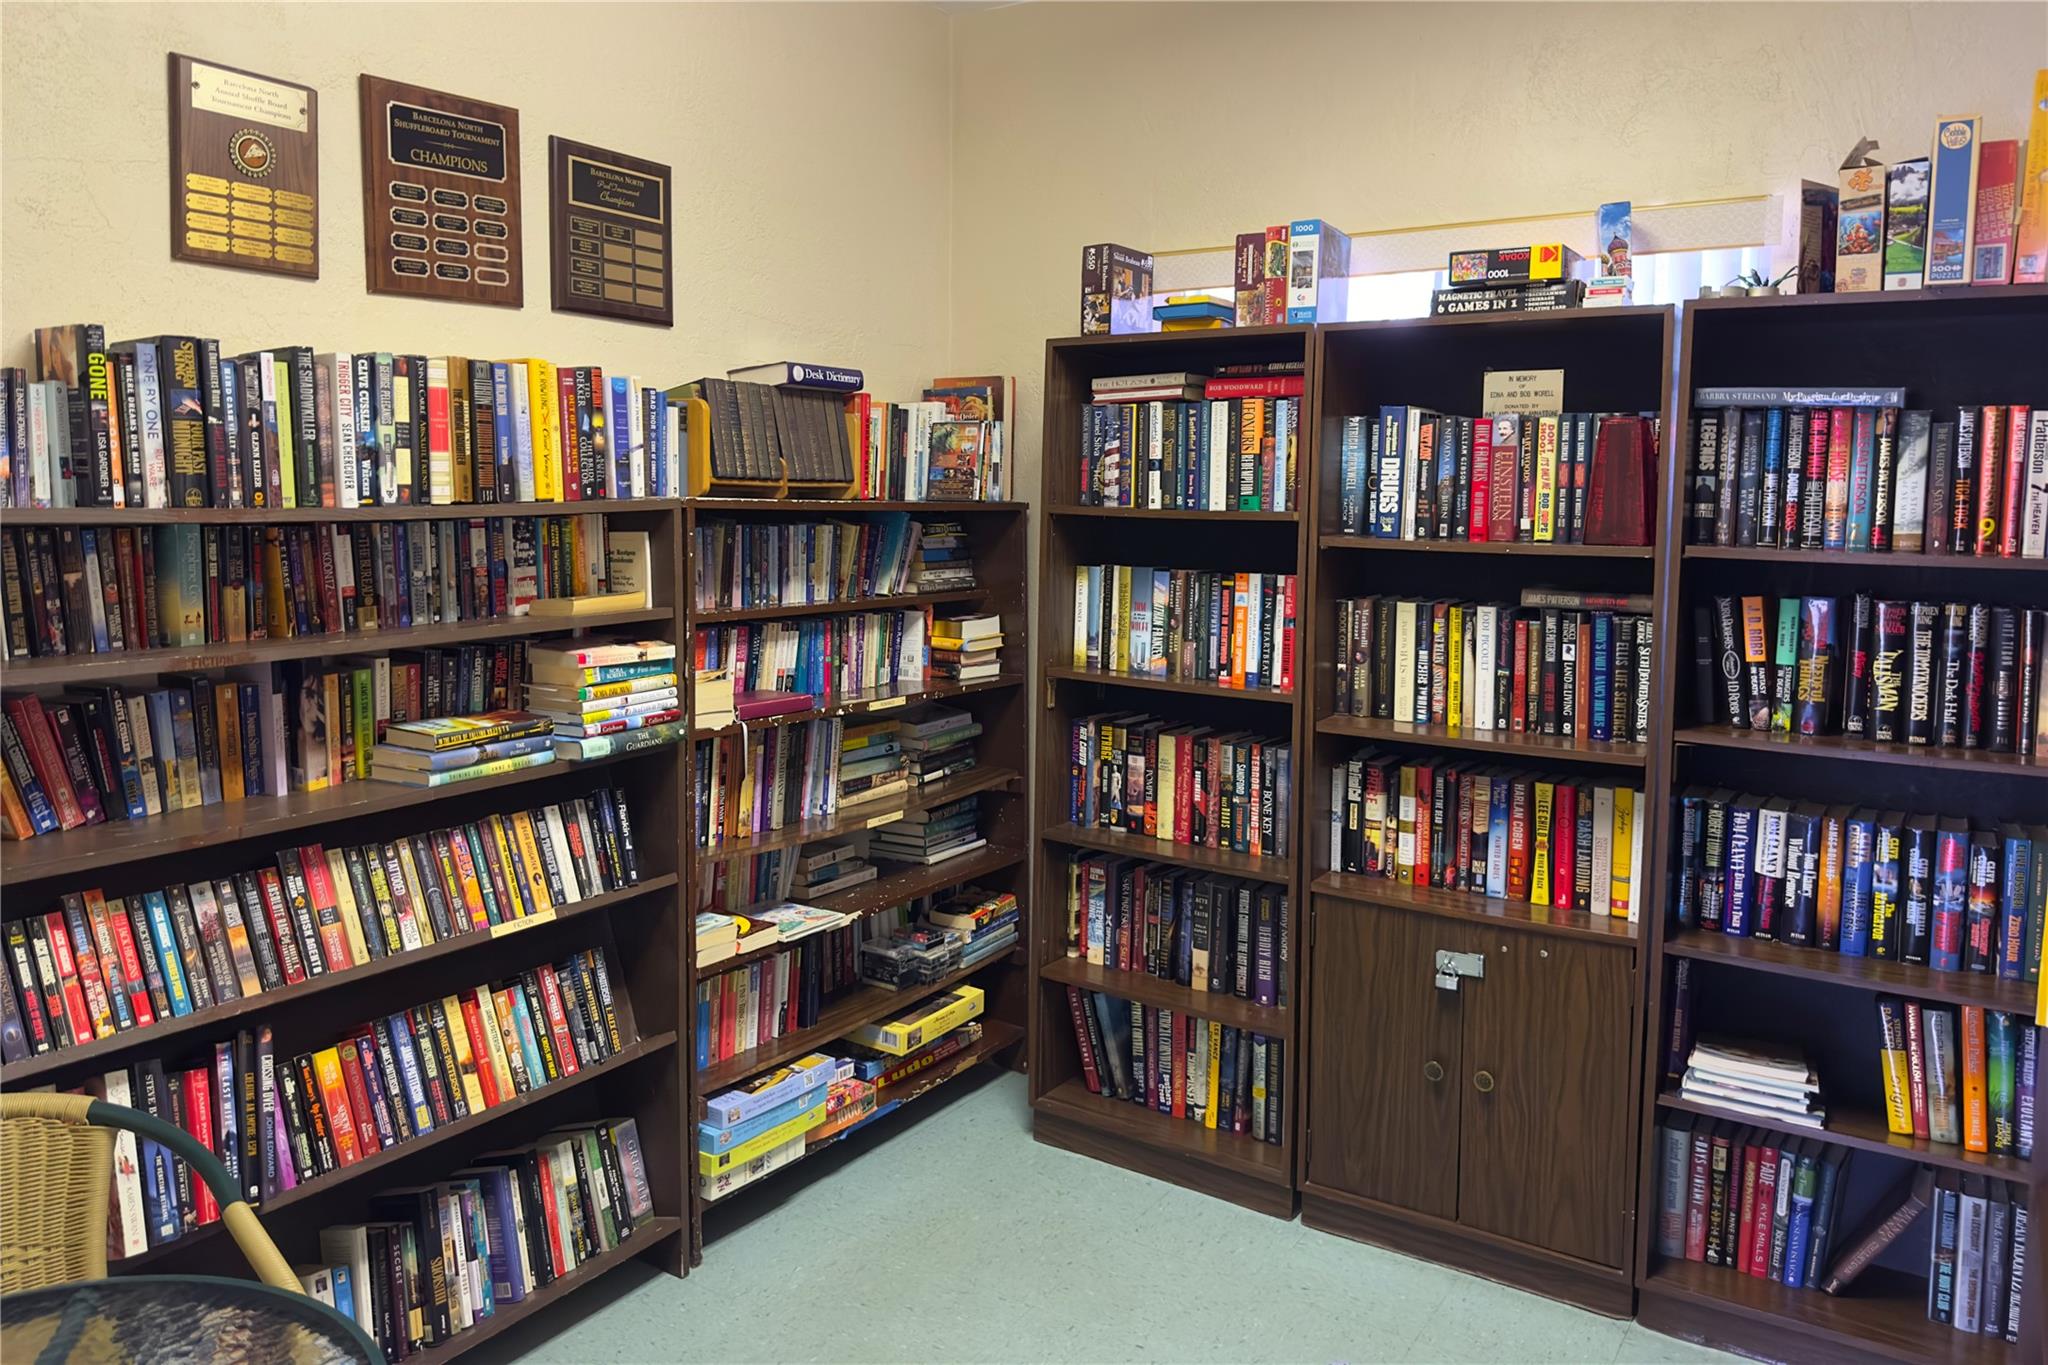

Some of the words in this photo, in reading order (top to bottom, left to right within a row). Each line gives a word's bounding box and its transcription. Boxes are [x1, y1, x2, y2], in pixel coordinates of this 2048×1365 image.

[458, 121, 483, 133] NORTH
[411, 149, 488, 172] CHAMPIONS
[1437, 305, 1445, 313] 6
[1448, 302, 1490, 312] GAMES
[1493, 300, 1506, 309] IN
[1438, 291, 1483, 301] MAGNETIC
[1485, 289, 1519, 299] TRAVEL
[173, 350, 186, 380] KING
[180, 341, 196, 388] STEPHEN
[297, 352, 312, 368] THE
[358, 360, 369, 388] CLIVE
[88, 353, 106, 399] GONE
[338, 360, 349, 394] TRIGGER
[575, 371, 586, 406] DEKKER
[806, 368, 824, 380] Desk
[826, 371, 861, 386] Dictionary
[1224, 383, 1264, 391] WOODWARD
[299, 369, 316, 440] SHADOWKILLER
[340, 398, 352, 417] CITY
[360, 390, 370, 432] CUSSLER
[190, 421, 204, 449] FOUR
[1789, 415, 1804, 435] JAMES
[1959, 411, 1975, 432] JAMES
[97, 432, 106, 450] LISA
[172, 420, 193, 474] MIDNIGHT
[1547, 424, 1555, 453] DON'T
[1700, 419, 1717, 470] LEGENDS
[1787, 436, 1801, 469] PATTERSON
[1878, 438, 1891, 467] JAMES
[1957, 433, 1973, 468] PATTERSON
[98, 451, 108, 487] GARDNER
[193, 451, 206, 474] PAST
[1240, 455, 1254, 495] REDEMPTION
[1380, 458, 1400, 513] DRUGS
[1763, 472, 1778, 491] JAMES
[1786, 473, 1799, 502] DOUBLE
[1955, 479, 1971, 500] TICK
[1762, 493, 1777, 526] PATTERSON
[1876, 469, 1890, 525] PATTERSON
[1540, 511, 1548, 532] HOPE
[1785, 503, 1798, 531] CROSS
[1803, 492, 1823, 536] PATTERSON
[1954, 504, 1970, 529] TOCK
[322, 551, 335, 590] KOONTZ
[1264, 598, 1272, 609] IN
[1481, 611, 1490, 632] JODI
[1262, 623, 1272, 675] HEARTBEAT
[1481, 634, 1489, 671] PICOULT
[1616, 642, 1629, 665] ELLIS
[1915, 630, 1932, 648] THE
[1564, 662, 1573, 682] LAND
[1615, 670, 1627, 688] LIFE
[1798, 660, 1811, 701] THINGS
[1811, 655, 1829, 702] NEEDFUL
[1873, 650, 1903, 711] TALISMAN
[1946, 660, 1960, 678] The
[1783, 667, 1792, 702] STRANGERS
[1910, 649, 1931, 721] TOMMYKNOCKERS
[1945, 680, 1959, 700] Dark
[114, 700, 126, 720] CLIVE
[1563, 691, 1572, 715] LIVING
[1613, 691, 1626, 735] SENTENCE
[1944, 702, 1957, 724] Half
[119, 722, 131, 753] CUSSLER
[626, 738, 662, 751] GUARDIANS
[638, 732, 649, 740] THE
[1100, 726, 1113, 760] OUTRAGE
[28, 792, 49, 818] dust
[1263, 790, 1273, 815] BONE
[1514, 784, 1524, 817] HARLAN
[1263, 817, 1272, 835] KEY
[1512, 821, 1523, 849] COBEN
[1577, 820, 1591, 845] CASH
[1707, 809, 1724, 837] ROBERT
[1732, 812, 1750, 834] TOM
[1705, 838, 1722, 867] LUDLUM
[1730, 834, 1749, 872] CLANCY
[1786, 838, 1803, 870] Without
[1849, 824, 1860, 868] CUSSLER
[1576, 850, 1590, 893] LANDING
[1804, 853, 1818, 869] Tom
[387, 859, 406, 895] TATTOOED
[1784, 871, 1802, 907] Remorse
[1798, 870, 1817, 898] Clancy
[1872, 892, 1887, 940] NAVIGATOR
[1885, 903, 1896, 917] The
[177, 915, 191, 950] SUMMONS
[301, 915, 312, 936] RISK
[2008, 915, 2022, 939] ZERO
[118, 927, 130, 944] JACK
[124, 946, 138, 978] HIGGINS
[136, 921, 149, 939] JACK
[145, 941, 159, 972] HIGGINS
[305, 939, 319, 967] AGENT
[1258, 927, 1272, 956] DEADLY
[2006, 940, 2020, 962] HOUR
[1258, 960, 1271, 980] RICH
[190, 972, 203, 1006] GRISHAM
[200, 979, 209, 998] JOHN
[1882, 1007, 1895, 1049] BAXTER
[220, 1055, 229, 1072] THE
[261, 1055, 275, 1091] CROSSING
[438, 1028, 451, 1053] JAMES
[445, 1054, 461, 1099] PATTERSON
[878, 1054, 934, 1088] Ludo
[145, 1074, 157, 1105] STEVE
[222, 1077, 231, 1100] LAST
[262, 1092, 275, 1112] OVER
[1889, 1076, 1905, 1119] origin
[223, 1103, 233, 1125] WIFE
[836, 1104, 862, 1124] 1000
[2019, 1095, 2034, 1147] EXULTANT
[627, 1140, 642, 1179] GREG
[1759, 1161, 1776, 1187] FADE
[1759, 1203, 1768, 1229] KYLE
[2015, 1208, 2028, 1242] DEAN
[1754, 1232, 1766, 1263] MILLS
[2010, 1243, 2024, 1292] KOONTZ
